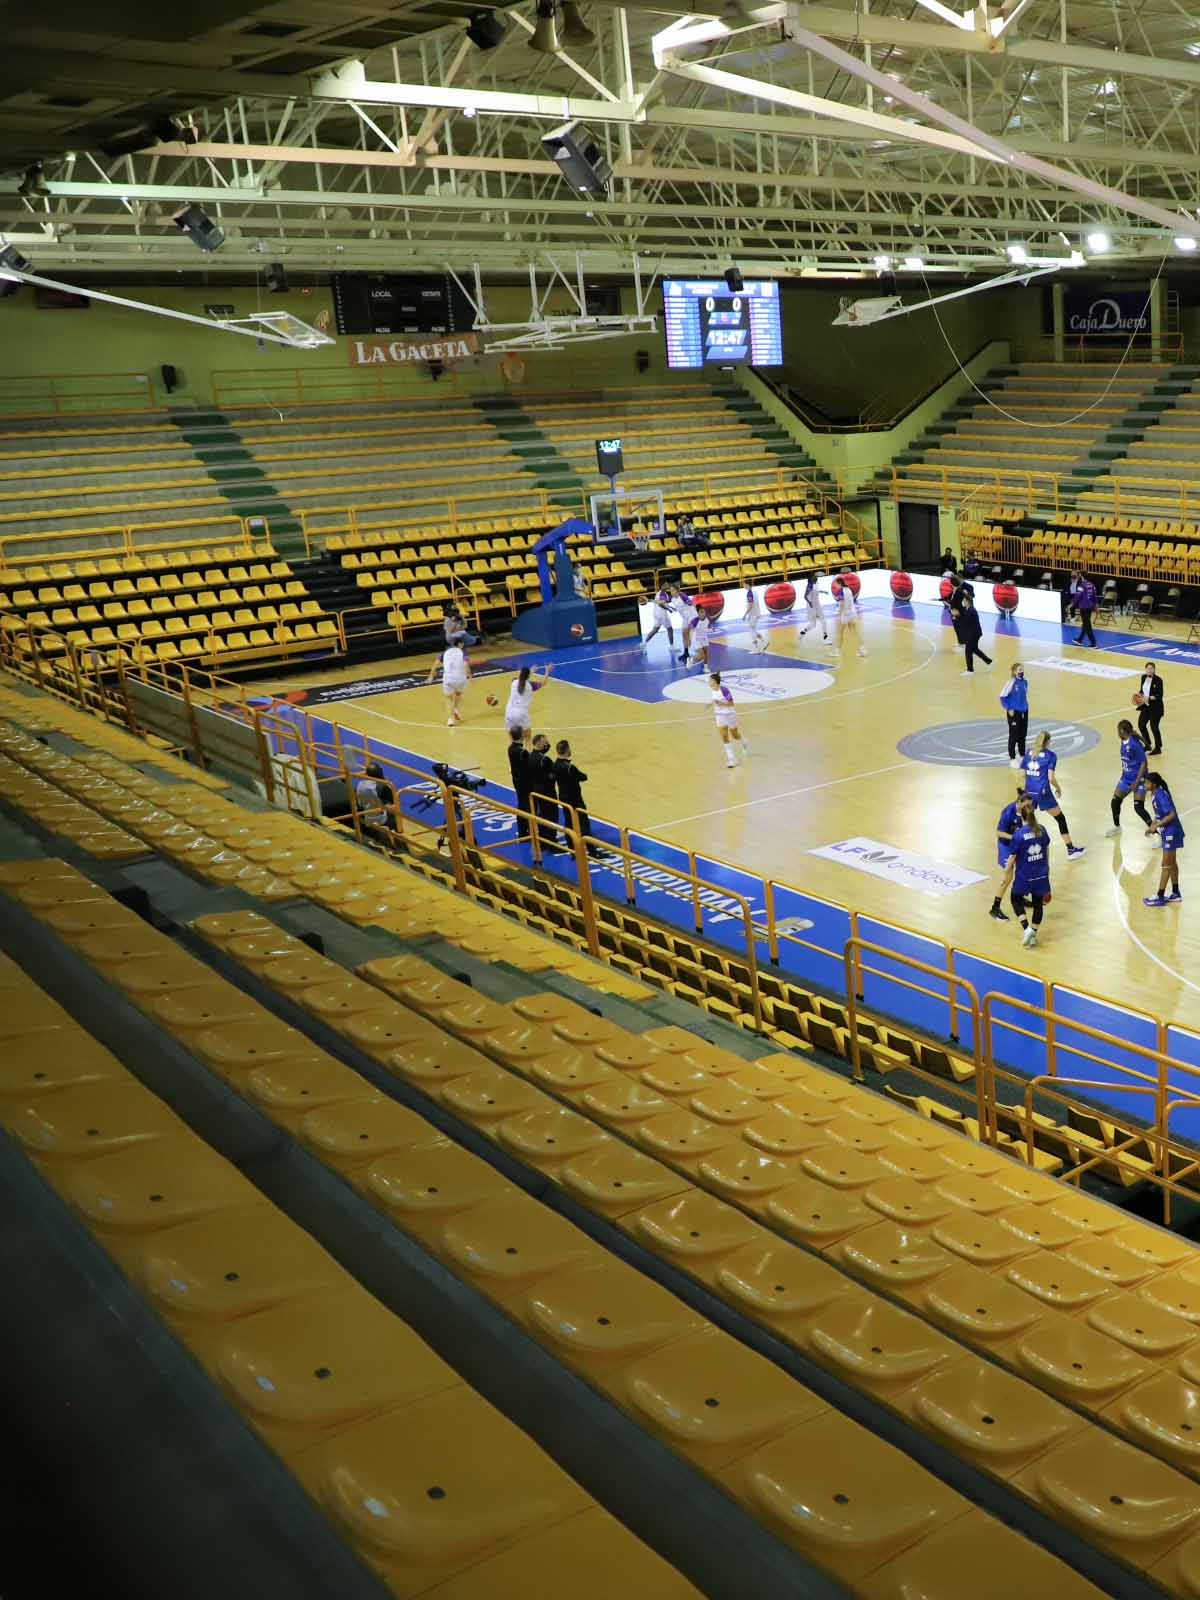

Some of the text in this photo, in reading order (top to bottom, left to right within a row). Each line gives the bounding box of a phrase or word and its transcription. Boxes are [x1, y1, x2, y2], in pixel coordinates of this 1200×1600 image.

[705, 297, 715, 312] 0
[732, 297, 742, 312] 0
[1070, 299, 1147, 334] Caja Duero
[708, 330, 743, 345] 12:47
[354, 339, 472, 364] LA GACETA
[887, 862, 964, 889] endesa
